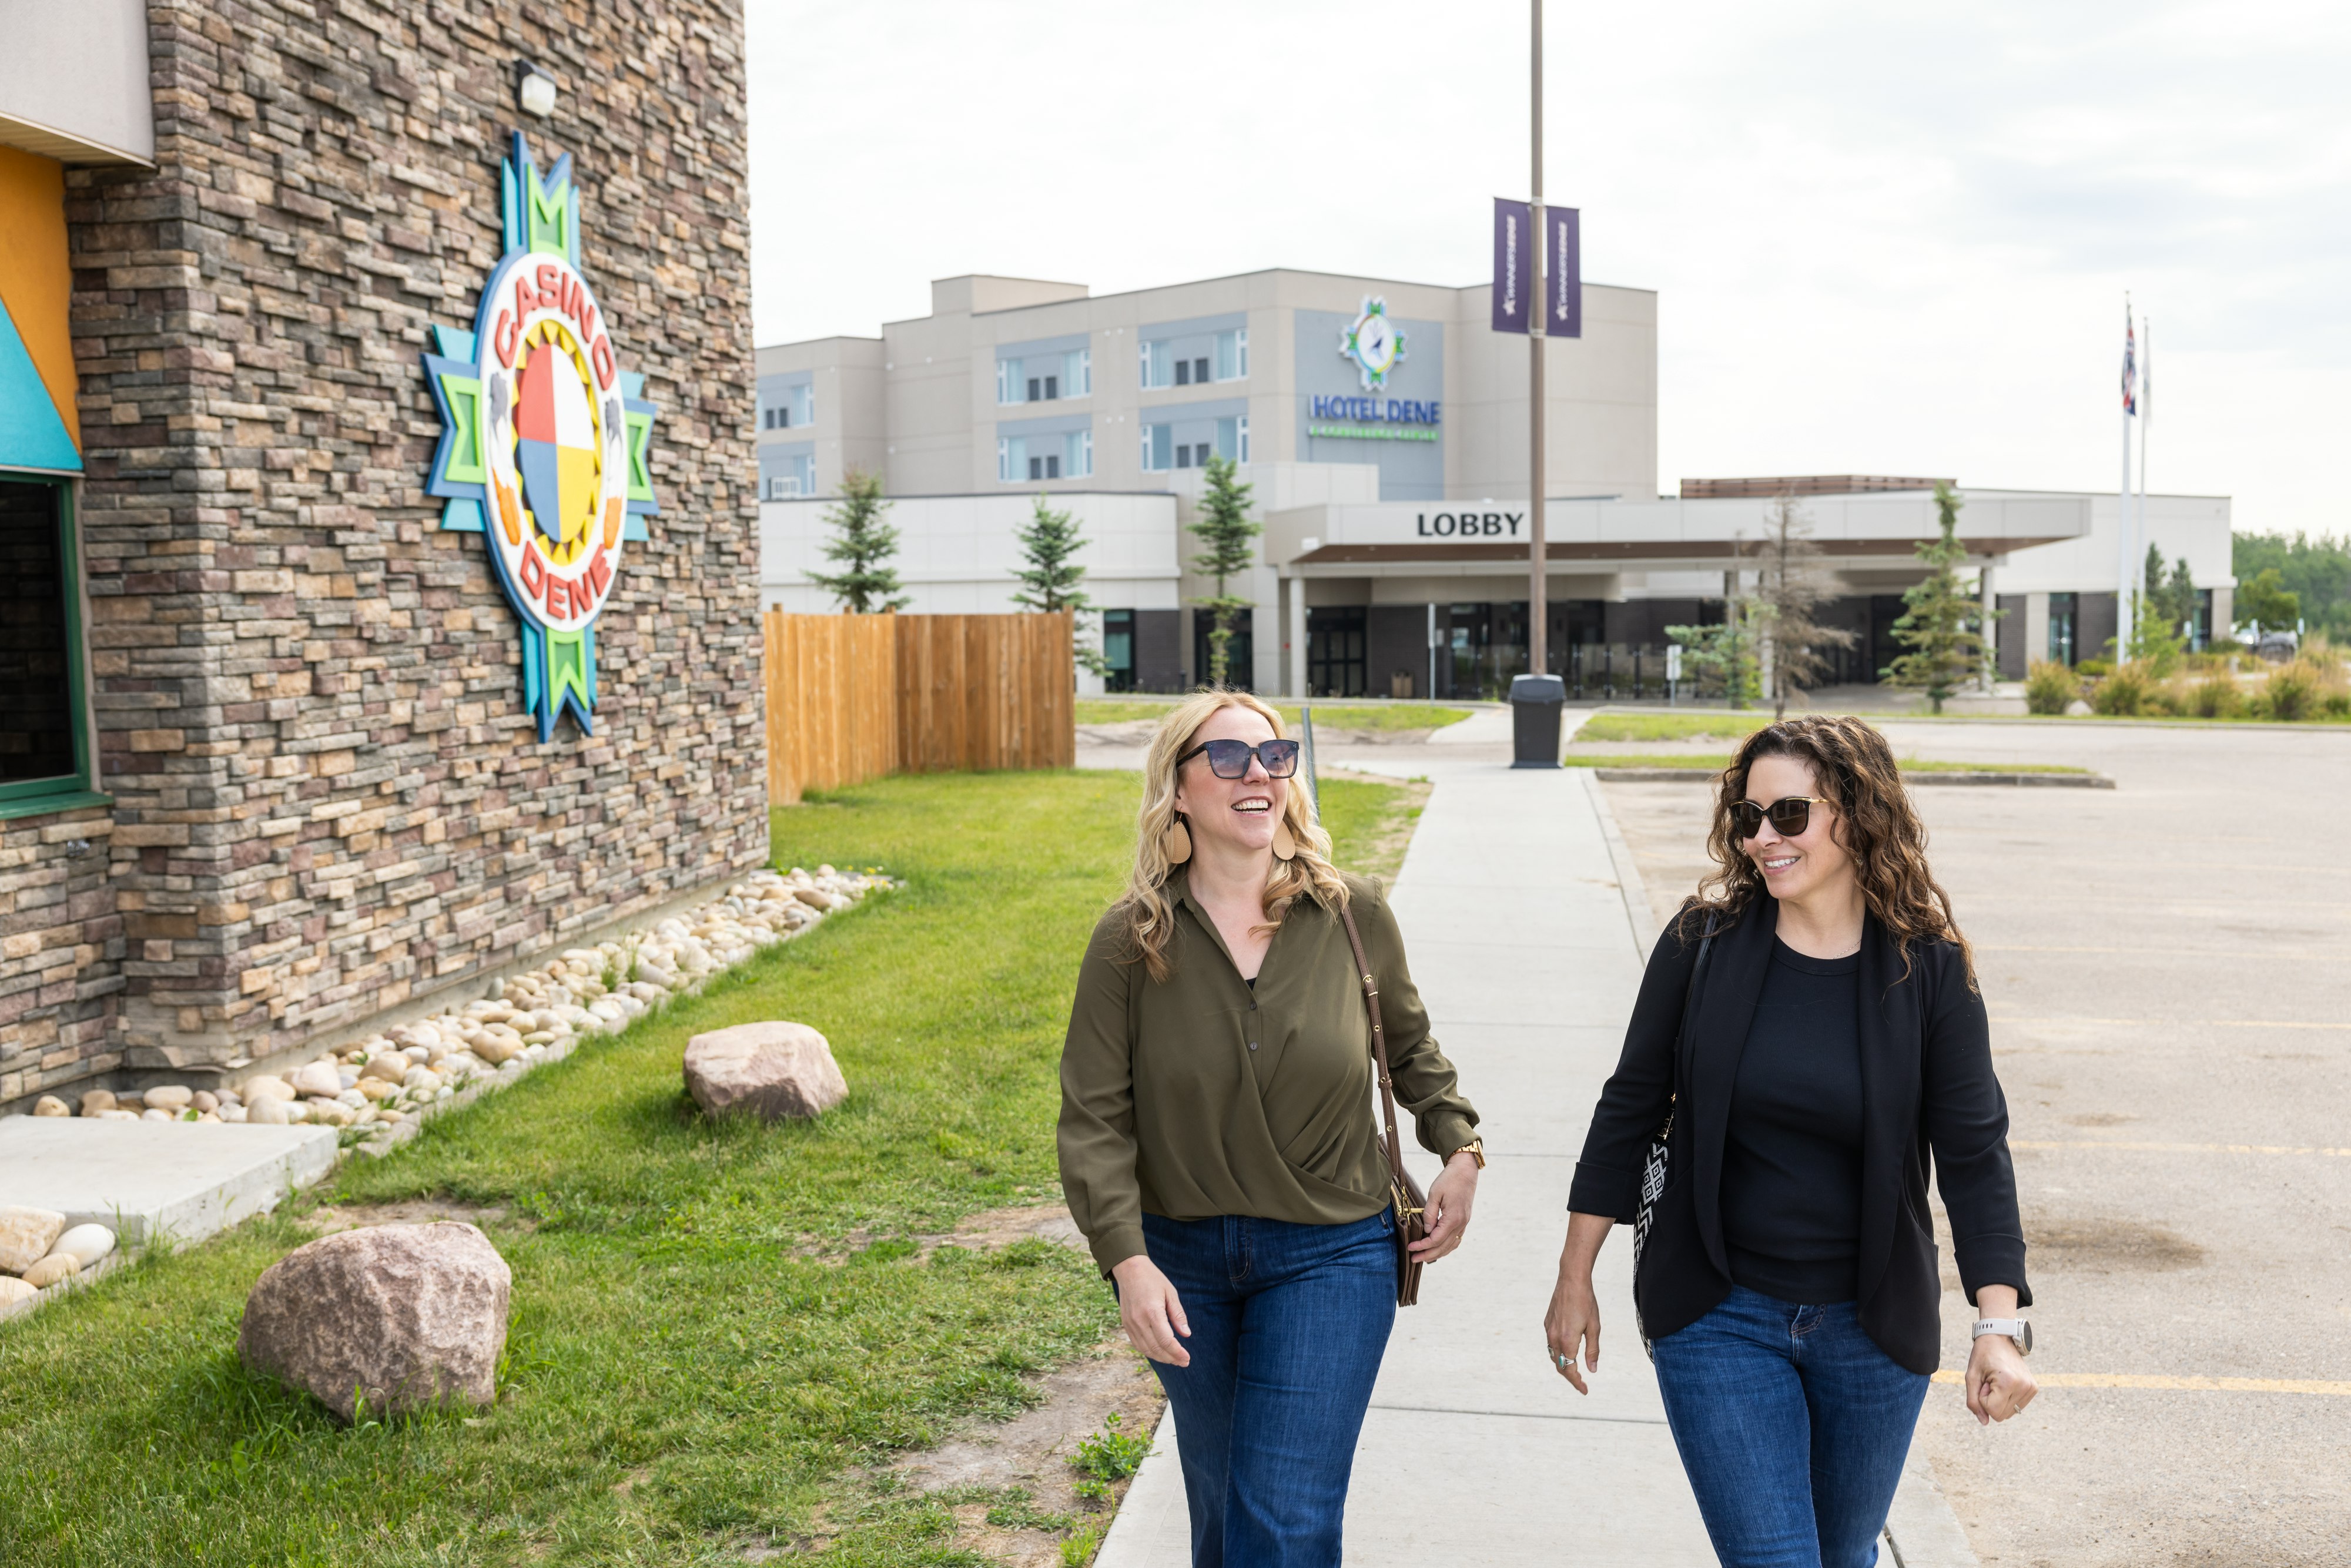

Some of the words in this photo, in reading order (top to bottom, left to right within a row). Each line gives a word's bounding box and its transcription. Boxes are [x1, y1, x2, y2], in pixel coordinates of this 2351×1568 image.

[495, 264, 615, 391] CASINO
[1311, 395, 1383, 421] HOTEL
[1384, 398, 1441, 424] DENE
[1418, 512, 1523, 537] LOBBY
[520, 540, 611, 620] DENE
